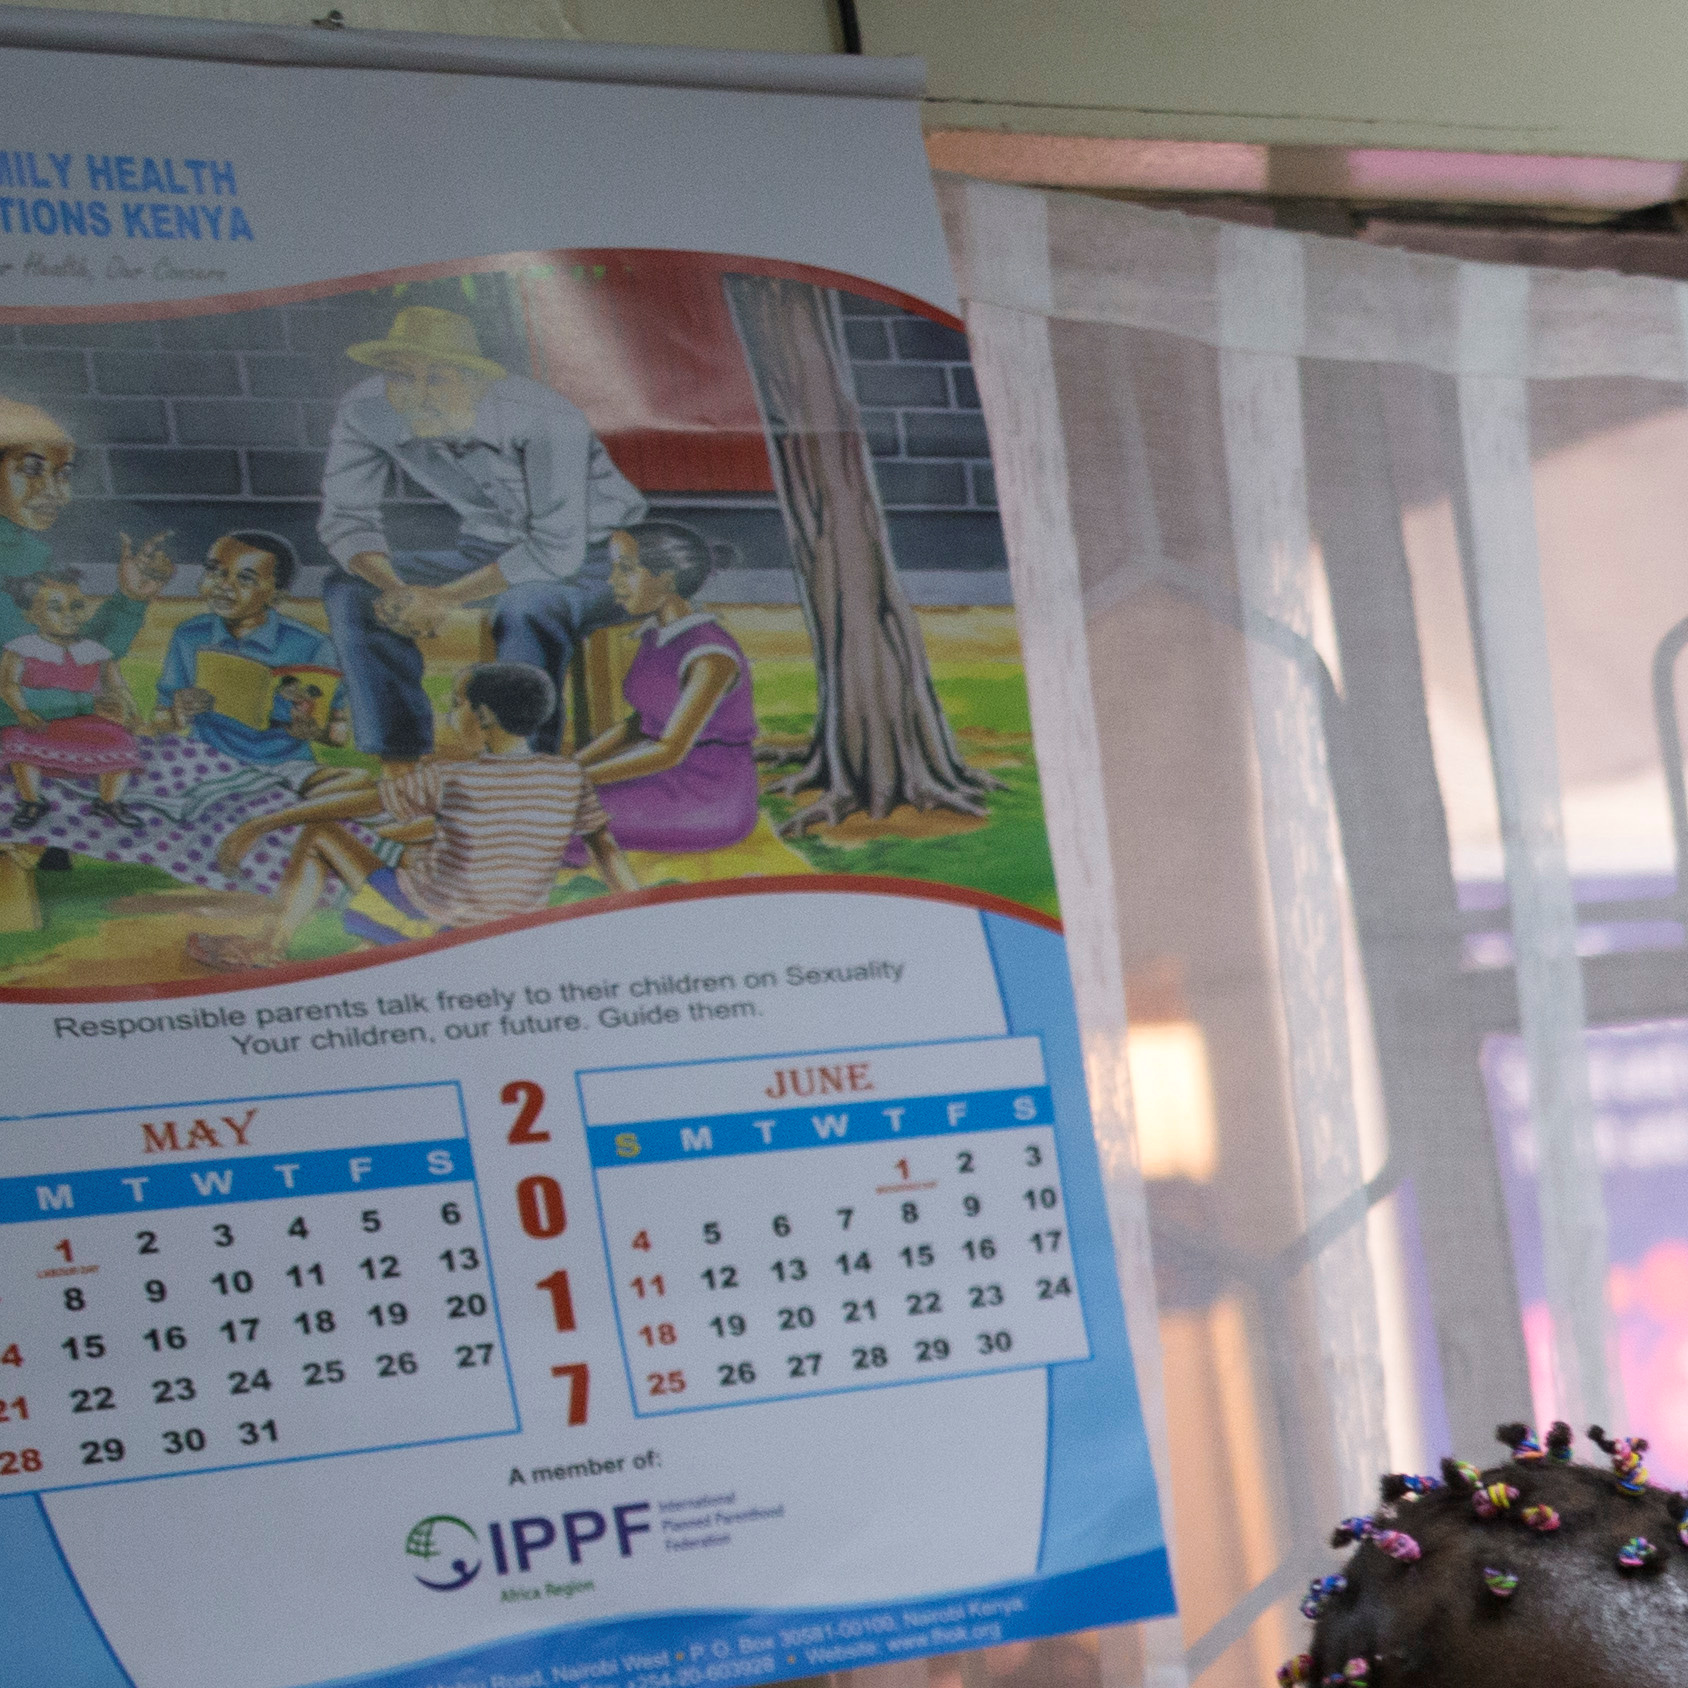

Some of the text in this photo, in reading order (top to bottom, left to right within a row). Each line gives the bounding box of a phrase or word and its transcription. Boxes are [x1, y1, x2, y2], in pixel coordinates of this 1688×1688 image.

[86, 153, 237, 196] HEALTH
[122, 201, 255, 241] KENYA
[54, 959, 906, 1041] Responsible parents talk freely to their children on Sexuality
[231, 1033, 300, 1057] Your
[310, 1024, 436, 1052] children,
[445, 1020, 489, 1041] our
[599, 1004, 680, 1030] Guide
[765, 1061, 875, 1100] JUNE
[141, 1108, 259, 1154] MAY
[614, 1096, 1038, 1159] S M T W T F S
[36, 1149, 454, 1212] M T W T F S
[897, 1145, 1043, 1180] 1 2 3
[55, 1201, 462, 1264] 1 2 3 4 5 6
[631, 1187, 1058, 1252] 4 5 6 7 8 9 10
[63, 1246, 480, 1312] 8 9 10 11 12 13
[631, 1229, 1064, 1299] 11 12 13 14 15 16 17
[61, 1334, 107, 1361] 15
[143, 1326, 188, 1353] 16
[220, 1317, 261, 1345] 17
[294, 1309, 337, 1336] 18
[366, 1302, 409, 1328] 19
[447, 1293, 488, 1319] 20
[638, 1276, 1073, 1349] 18 19 20 21 22 23 24
[70, 1386, 117, 1414] 22
[151, 1377, 197, 1405] 23
[228, 1369, 272, 1396] 24
[303, 1360, 346, 1387] 25
[376, 1352, 419, 1378] 26
[455, 1343, 496, 1370] 27
[646, 1331, 1014, 1397] 25 26 27 28 29 30
[0, 1419, 280, 1477] 28 29 30 31
[508, 1449, 663, 1487] A member of:
[488, 1500, 652, 1576] IPPF
[665, 1532, 732, 1554] Federation
[501, 1578, 596, 1603] Africa Region
[551, 1659, 618, 1682] Nairobi
[620, 1650, 671, 1673] West
[738, 1634, 775, 1654] Box
[902, 1606, 966, 1629] Nairobi
